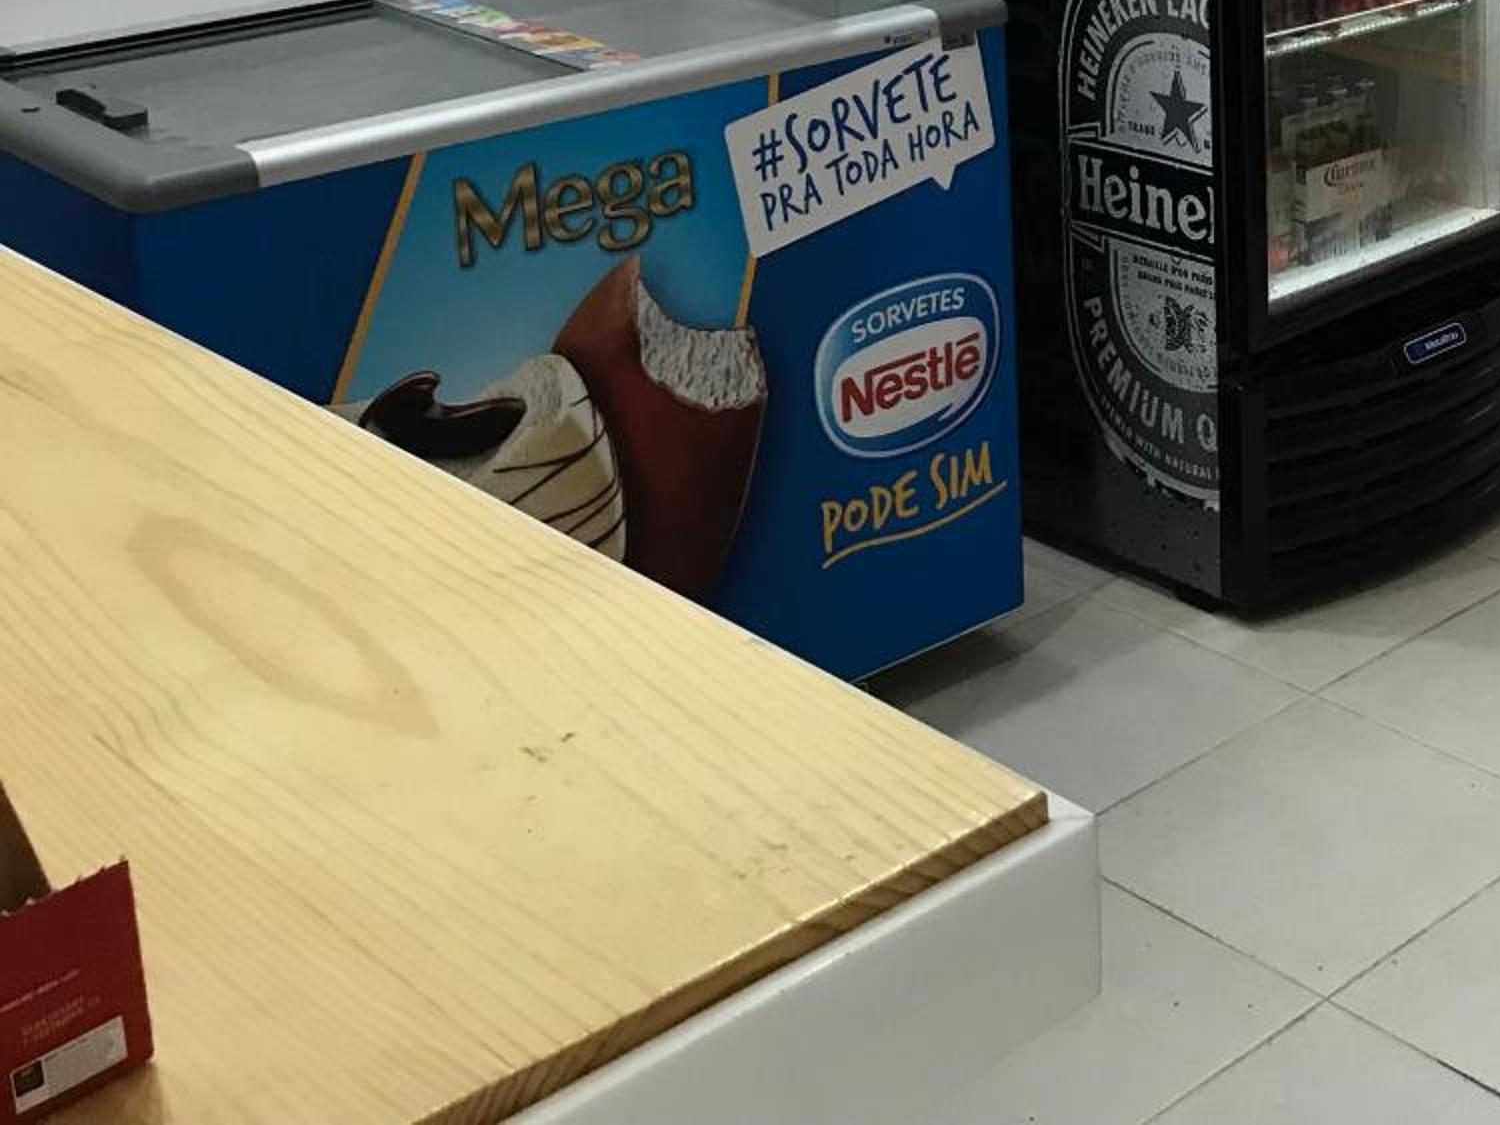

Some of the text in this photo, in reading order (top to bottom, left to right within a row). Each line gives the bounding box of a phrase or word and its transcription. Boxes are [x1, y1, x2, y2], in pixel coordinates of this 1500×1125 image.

[752, 52, 958, 183] #SORVETE
[759, 107, 982, 233] PRA TODA HORA
[450, 147, 696, 269] Mega
[850, 285, 966, 346] SORVETES
[1081, 295, 1187, 446] PREMIUM
[838, 330, 983, 425] Nestlé
[820, 440, 994, 554] PODE SIM
[1164, 454, 1213, 481] NATURAL
